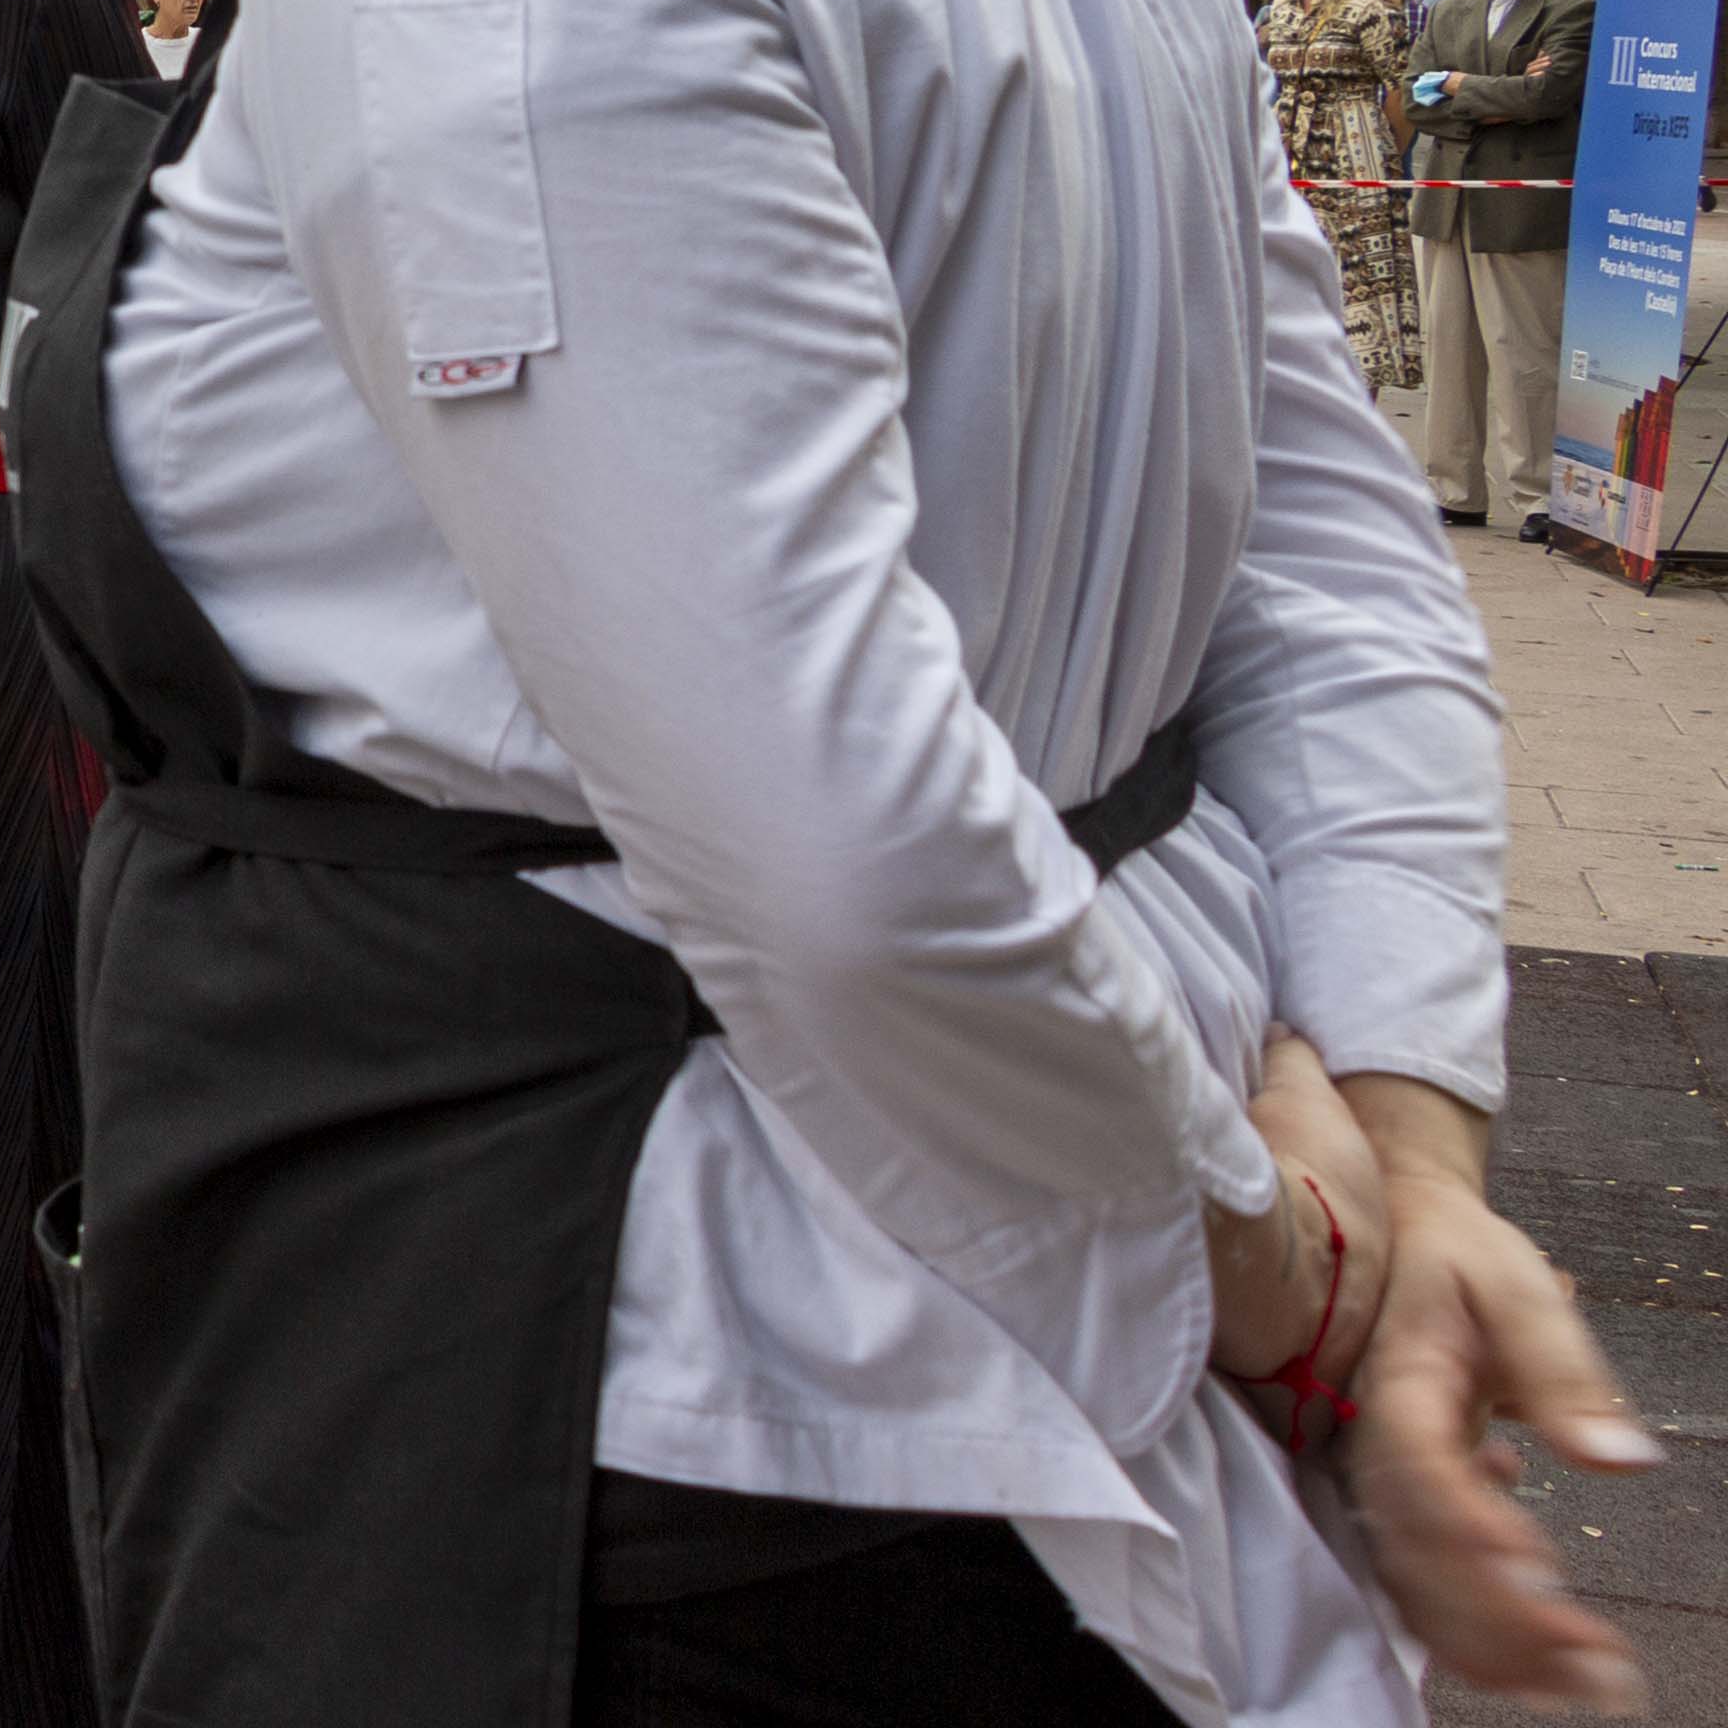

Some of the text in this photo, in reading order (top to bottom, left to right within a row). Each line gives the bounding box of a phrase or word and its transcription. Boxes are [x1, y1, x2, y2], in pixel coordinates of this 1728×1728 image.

[1608, 36, 1638, 86] III
[1641, 36, 1679, 59] Concurs
[1637, 66, 1697, 93] internacional
